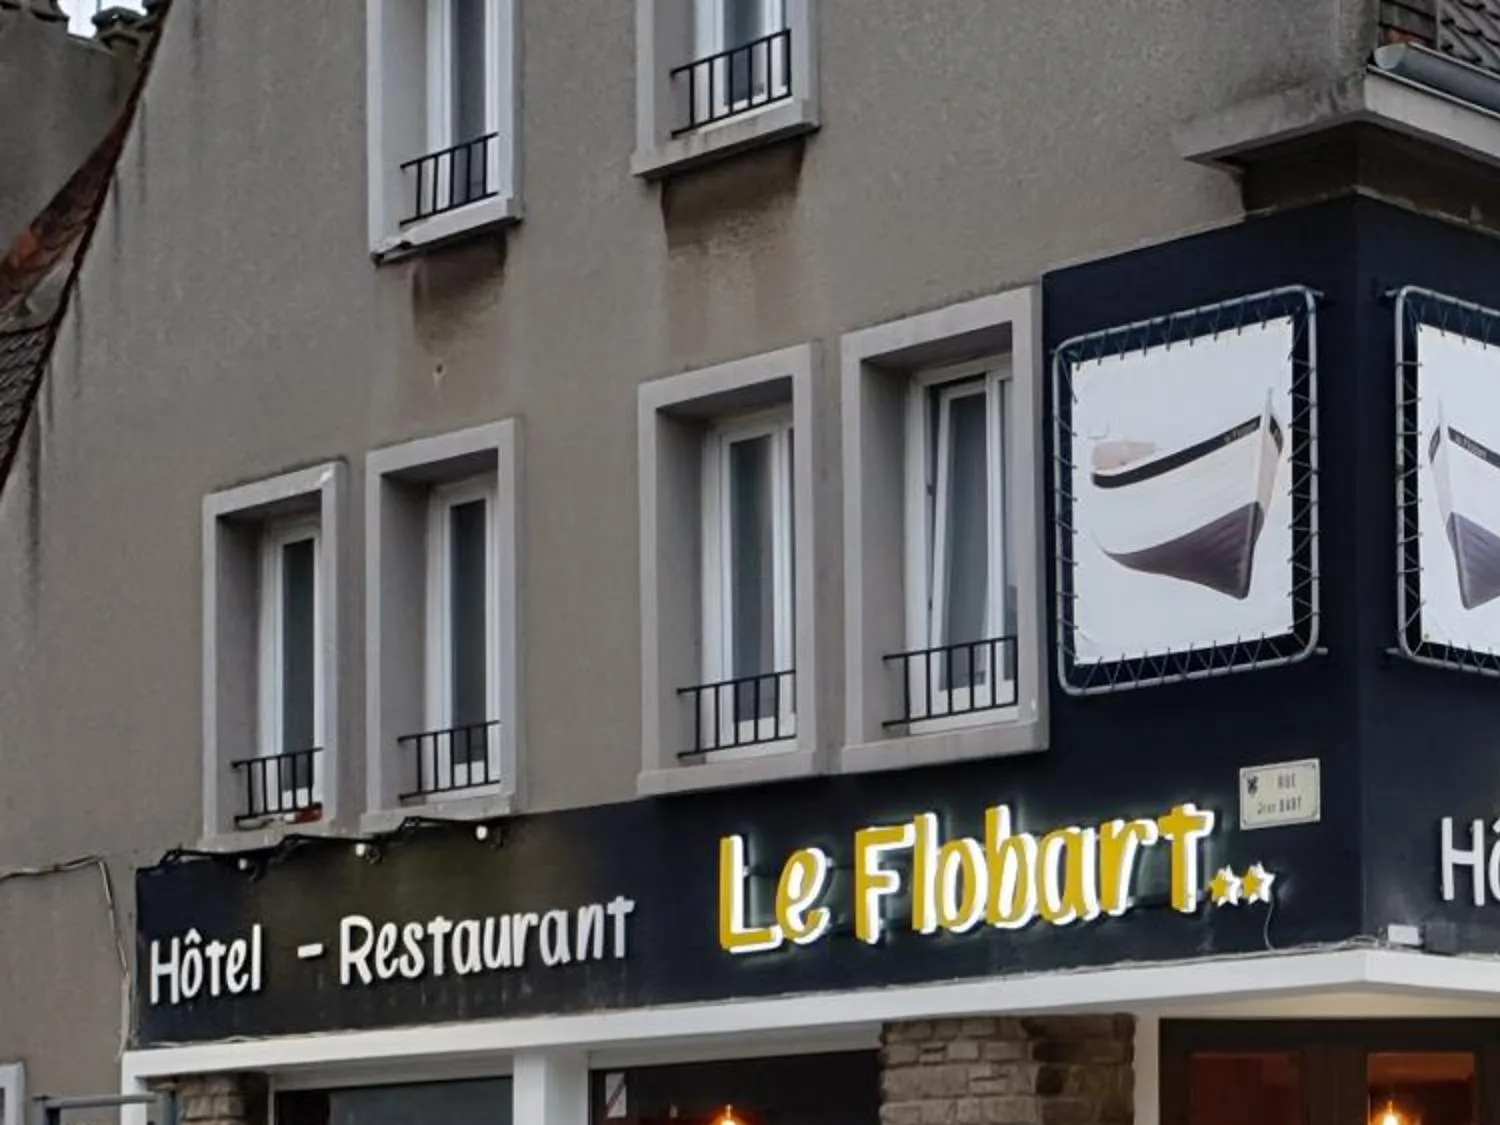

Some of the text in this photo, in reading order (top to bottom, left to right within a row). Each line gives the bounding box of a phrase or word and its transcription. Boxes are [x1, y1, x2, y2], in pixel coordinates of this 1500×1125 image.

[719, 803, 1215, 953] Le Flobart
[150, 924, 263, 1005] Hôtel
[339, 895, 636, 986] Restaurant
